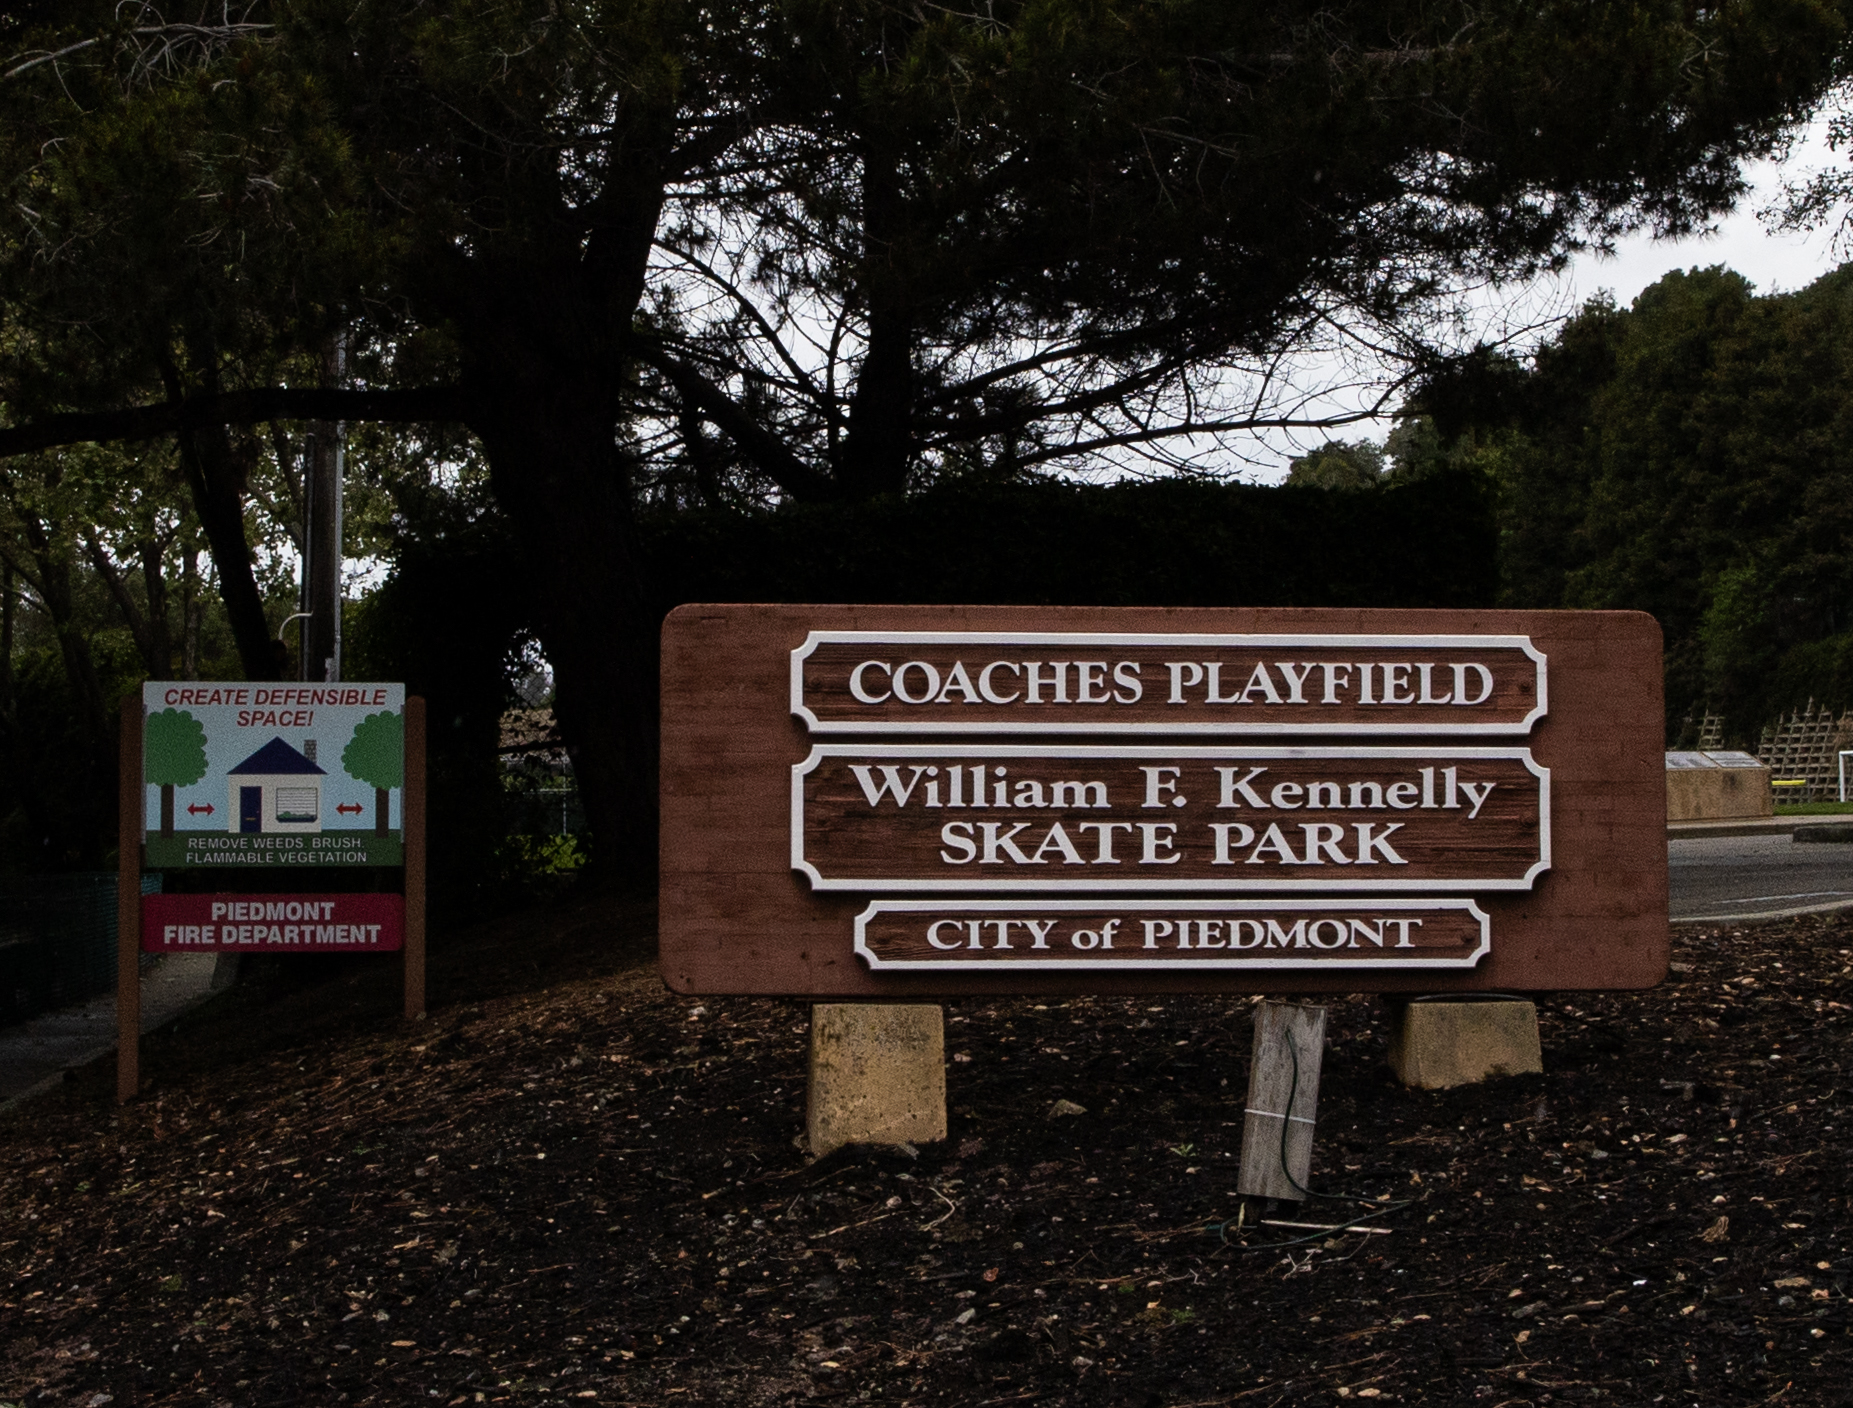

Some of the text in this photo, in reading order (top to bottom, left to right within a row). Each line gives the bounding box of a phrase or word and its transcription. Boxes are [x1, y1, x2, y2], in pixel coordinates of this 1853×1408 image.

[849, 660, 1494, 705] COACHES PLAYFIELD
[164, 689, 387, 706] CREATE DEFENSIBLE
[236, 710, 314, 727] SPACE!
[847, 764, 1496, 820] William F. Kennelly
[187, 838, 252, 849] REMOVE
[940, 821, 1409, 865] SKATE PARK
[186, 851, 367, 863] FLAMMABLE VEGETATION
[211, 902, 335, 921] PIEDMONT
[163, 924, 382, 944] FIRE DEPARTMENT
[927, 918, 1423, 951] CITY of PIEDMONT
